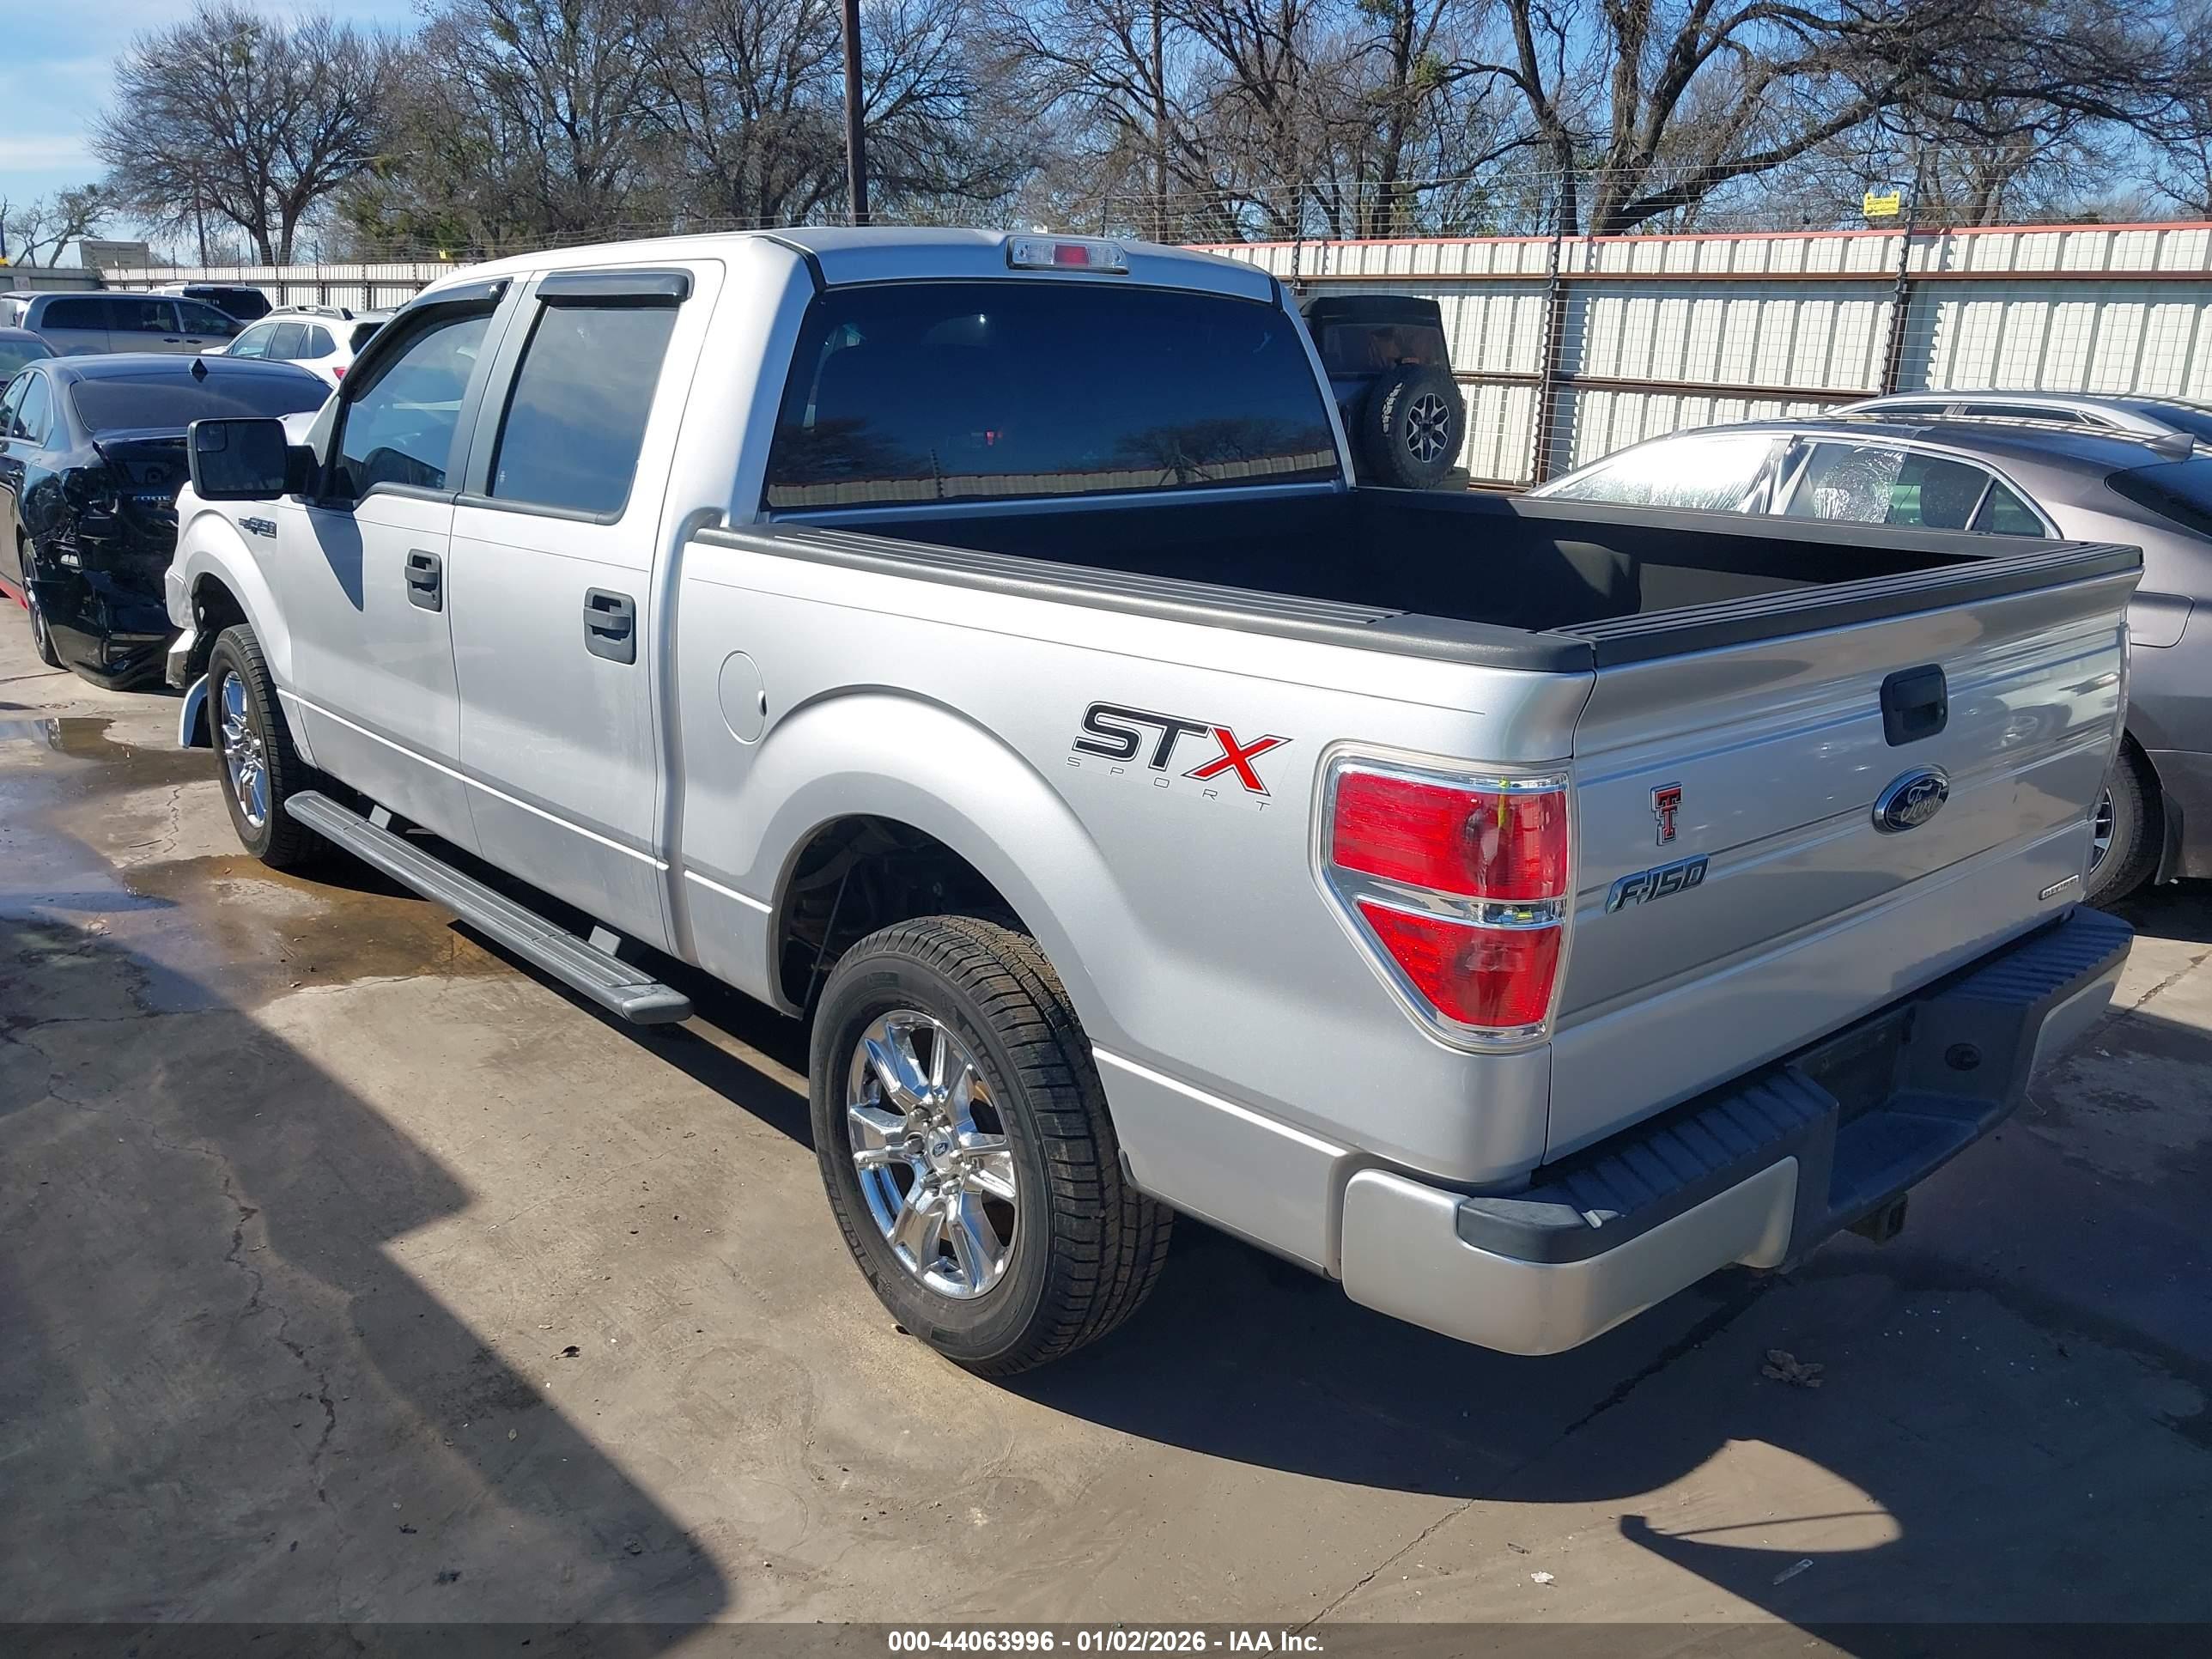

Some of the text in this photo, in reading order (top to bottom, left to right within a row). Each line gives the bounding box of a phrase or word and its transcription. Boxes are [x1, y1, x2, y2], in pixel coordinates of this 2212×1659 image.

[1072, 700, 1294, 797] STX
[1066, 757, 1270, 811] SPORT
[1899, 782, 1942, 823] Ford
[1607, 854, 1710, 914] F-150
